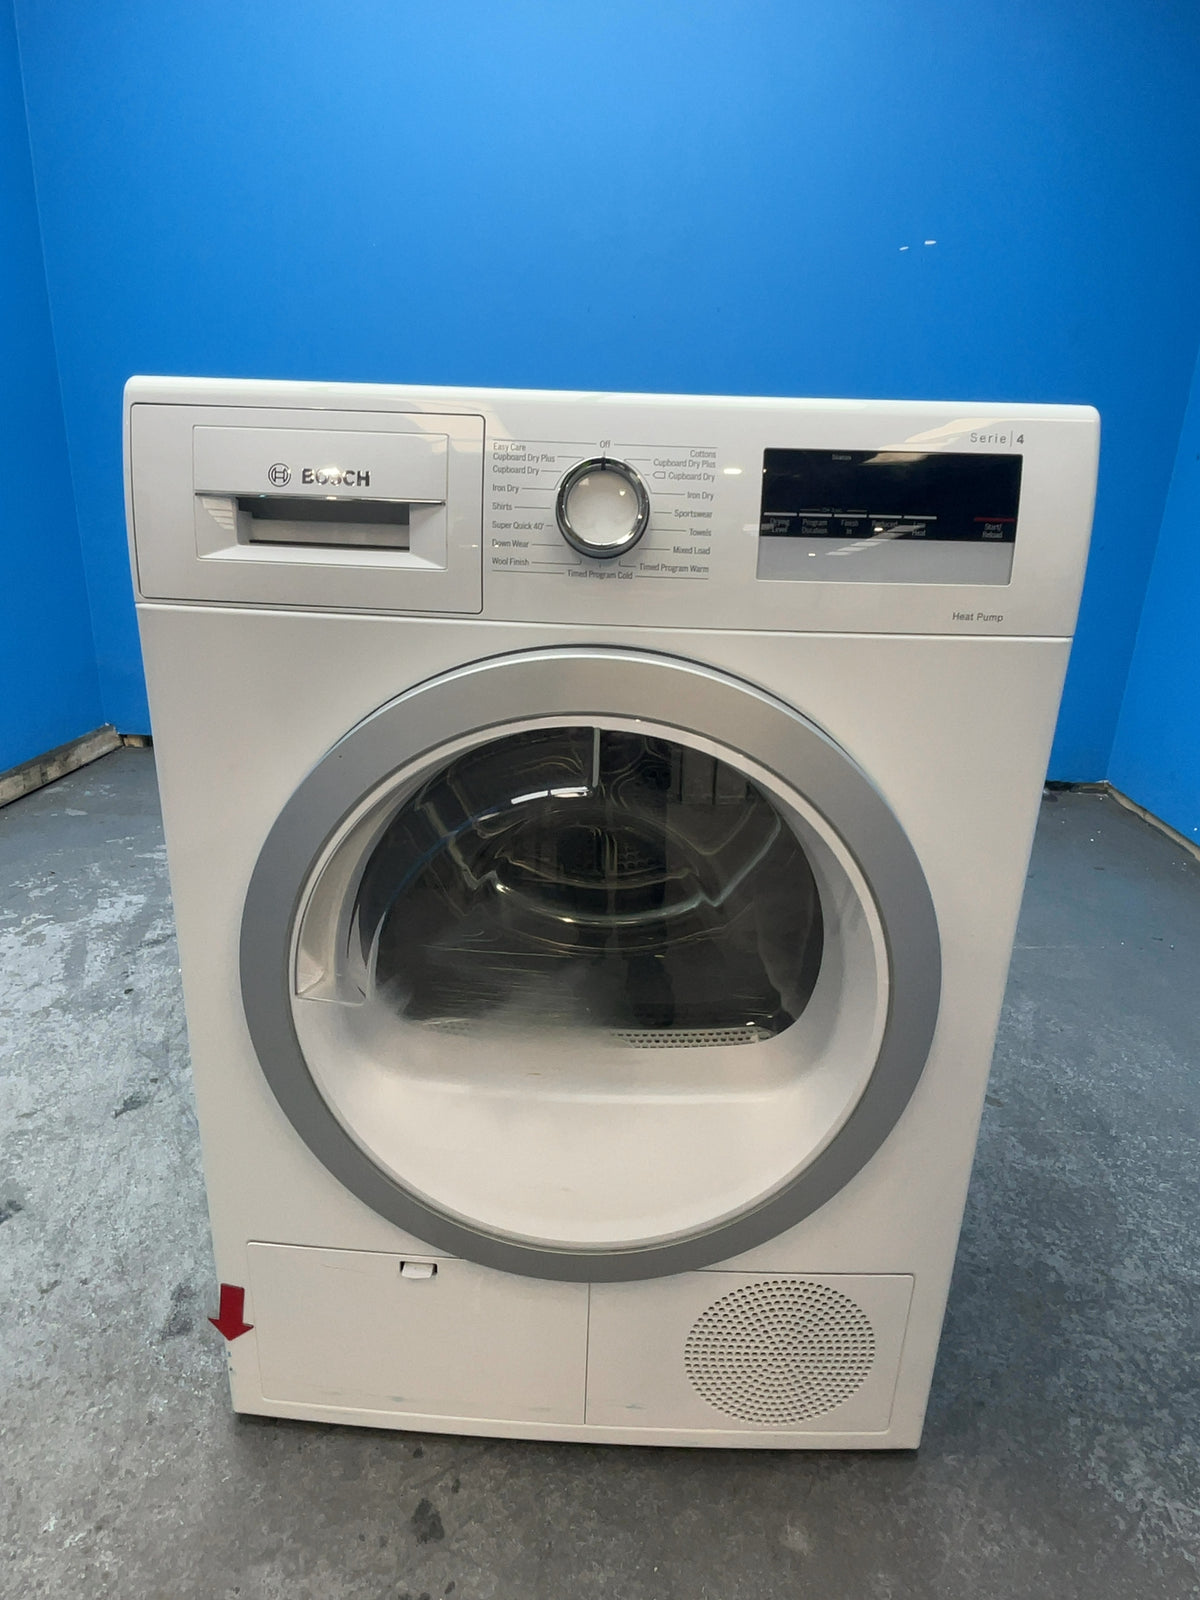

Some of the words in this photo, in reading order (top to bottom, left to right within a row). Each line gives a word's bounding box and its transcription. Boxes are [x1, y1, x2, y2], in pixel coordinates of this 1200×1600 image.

[970, 432, 1007, 444] Serie
[493, 442, 509, 452] Easy
[510, 443, 526, 451] Care
[599, 440, 611, 448] Off
[492, 453, 527, 462] Cupboard
[527, 454, 540, 463] Dry
[689, 449, 717, 458] Cottons
[653, 458, 687, 468] Cupboard
[687, 460, 701, 469] Dry
[701, 460, 716, 468] Plus
[492, 465, 526, 474] Cupboard
[526, 466, 540, 476] Dry
[668, 472, 702, 481] Cupboard
[702, 473, 715, 482] Dry
[492, 484, 507, 492] Iron
[507, 484, 520, 494] Dry
[687, 491, 702, 500] Iron
[702, 492, 714, 502] Dry
[491, 502, 513, 511] Shirts
[674, 509, 713, 518] Sportswear
[491, 521, 512, 530] Super
[512, 522, 532, 530] Quick
[689, 528, 712, 537] Towels
[491, 538, 512, 547] Down
[512, 540, 529, 548] Wear
[673, 546, 693, 554] Mixed
[693, 547, 711, 556] Load
[491, 557, 509, 566] Wool
[509, 558, 530, 566] Finish
[639, 562, 660, 571] Timed
[660, 563, 688, 573] Program
[689, 564, 710, 573] Warm
[567, 569, 588, 578] Timed
[588, 570, 616, 580] Program
[617, 571, 634, 580] Cold
[952, 612, 974, 621] Heat
[976, 613, 1004, 623] Pump
